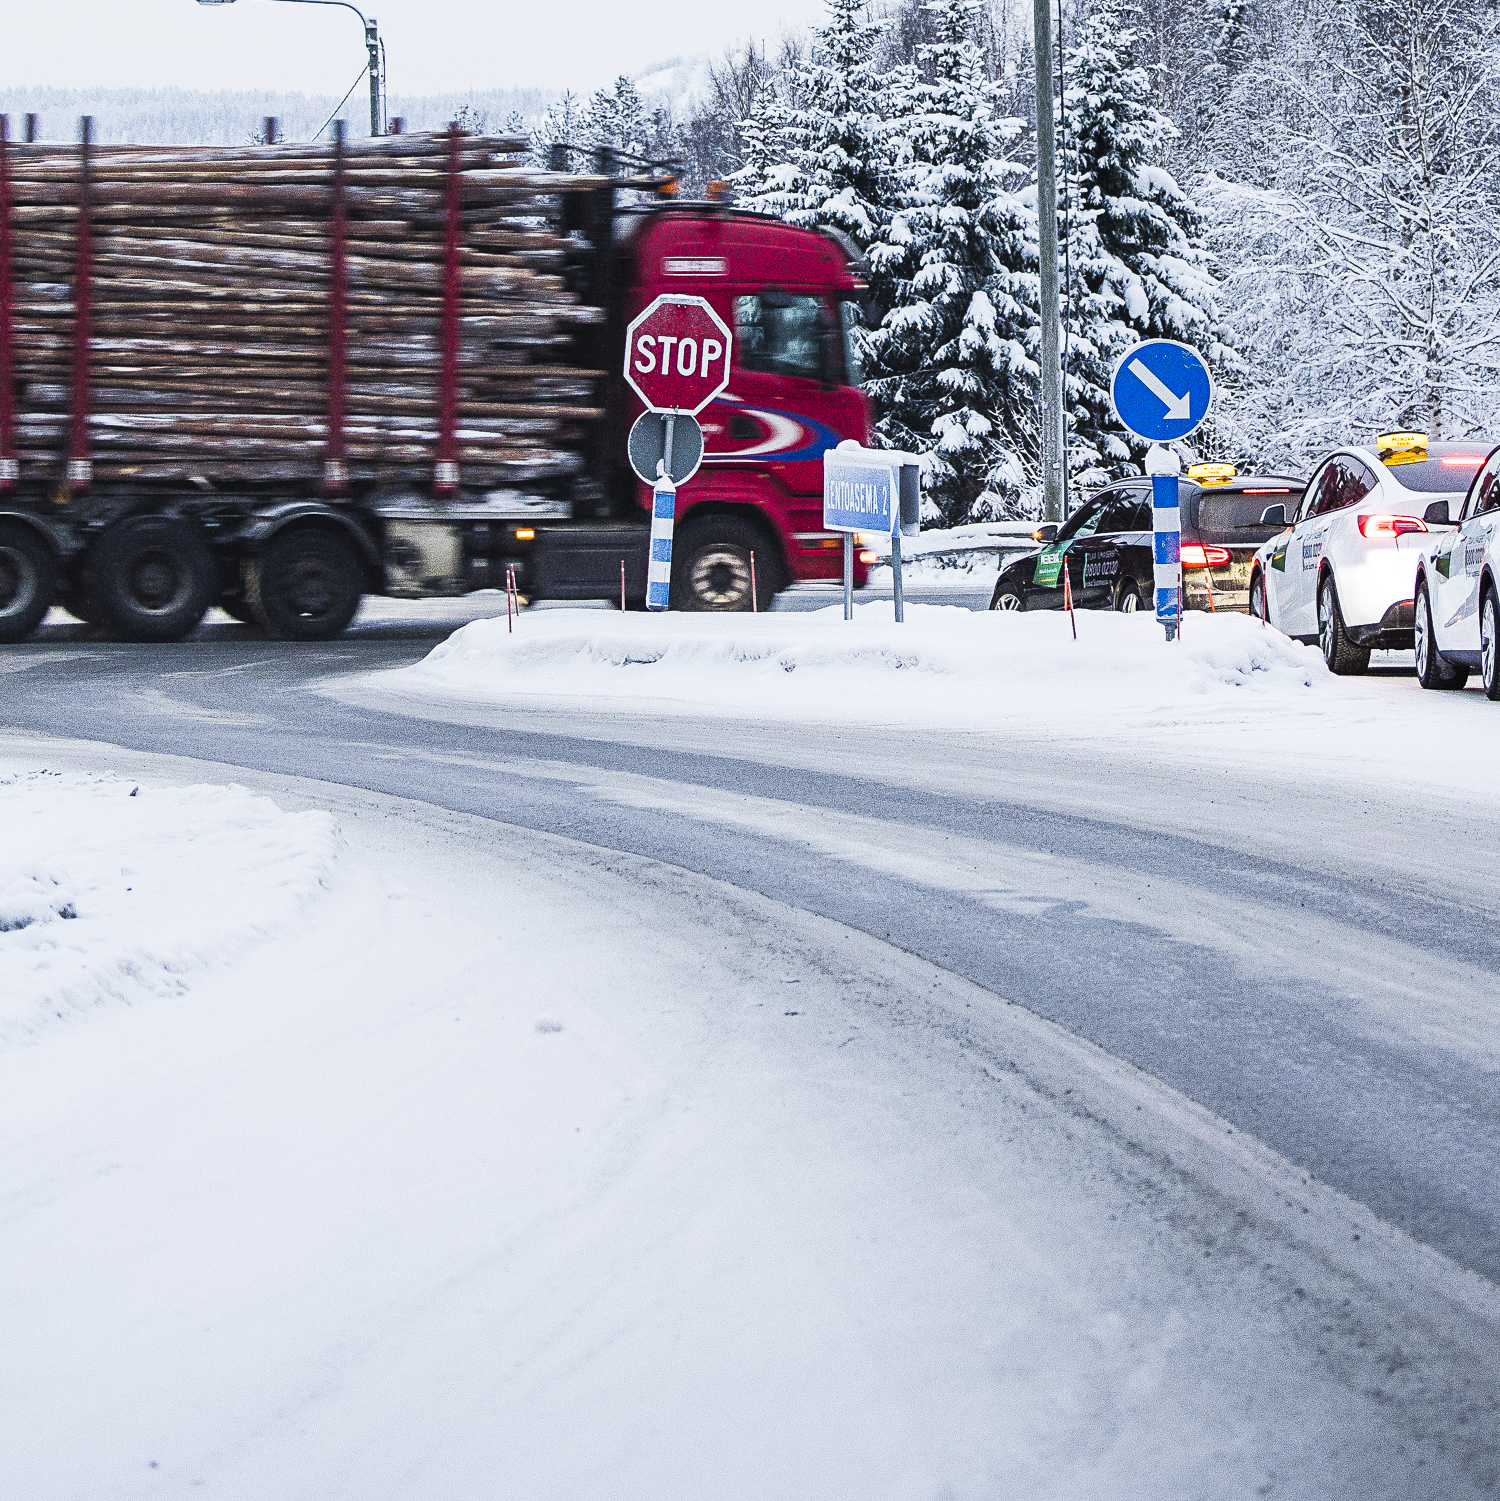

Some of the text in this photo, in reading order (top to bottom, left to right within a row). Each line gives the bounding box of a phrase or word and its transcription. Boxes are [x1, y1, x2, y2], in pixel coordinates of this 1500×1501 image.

[634, 334, 723, 378] STOP
[826, 480, 888, 516] LENTOASEMA 2
